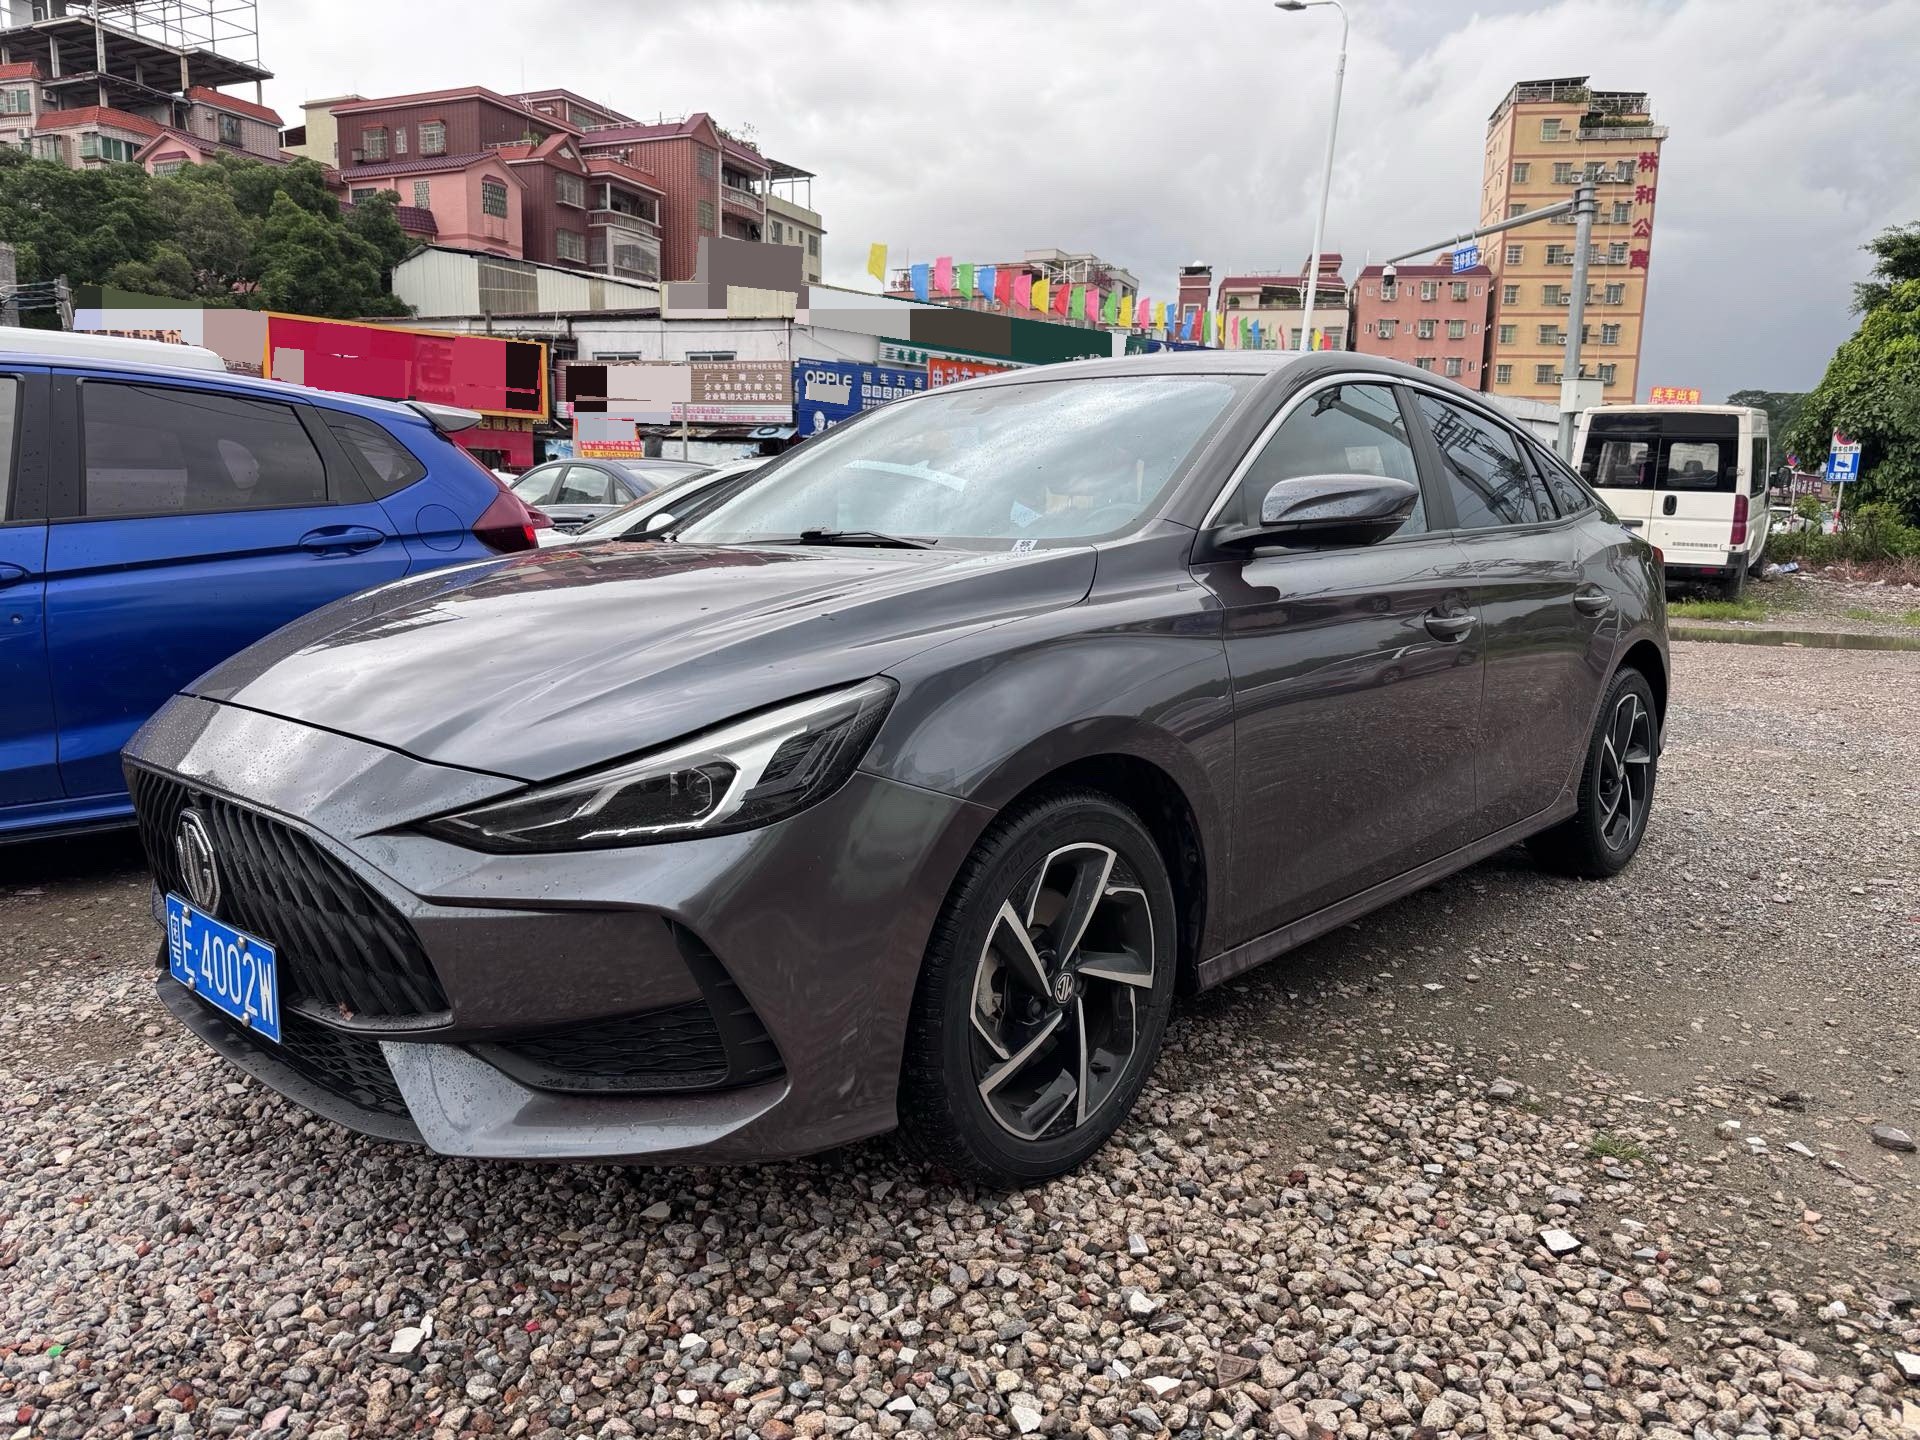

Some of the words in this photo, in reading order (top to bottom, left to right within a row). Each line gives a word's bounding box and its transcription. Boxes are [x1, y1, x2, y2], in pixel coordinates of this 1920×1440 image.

[805, 369, 853, 388] OPPLE
[862, 371, 924, 389] 恒生五金
